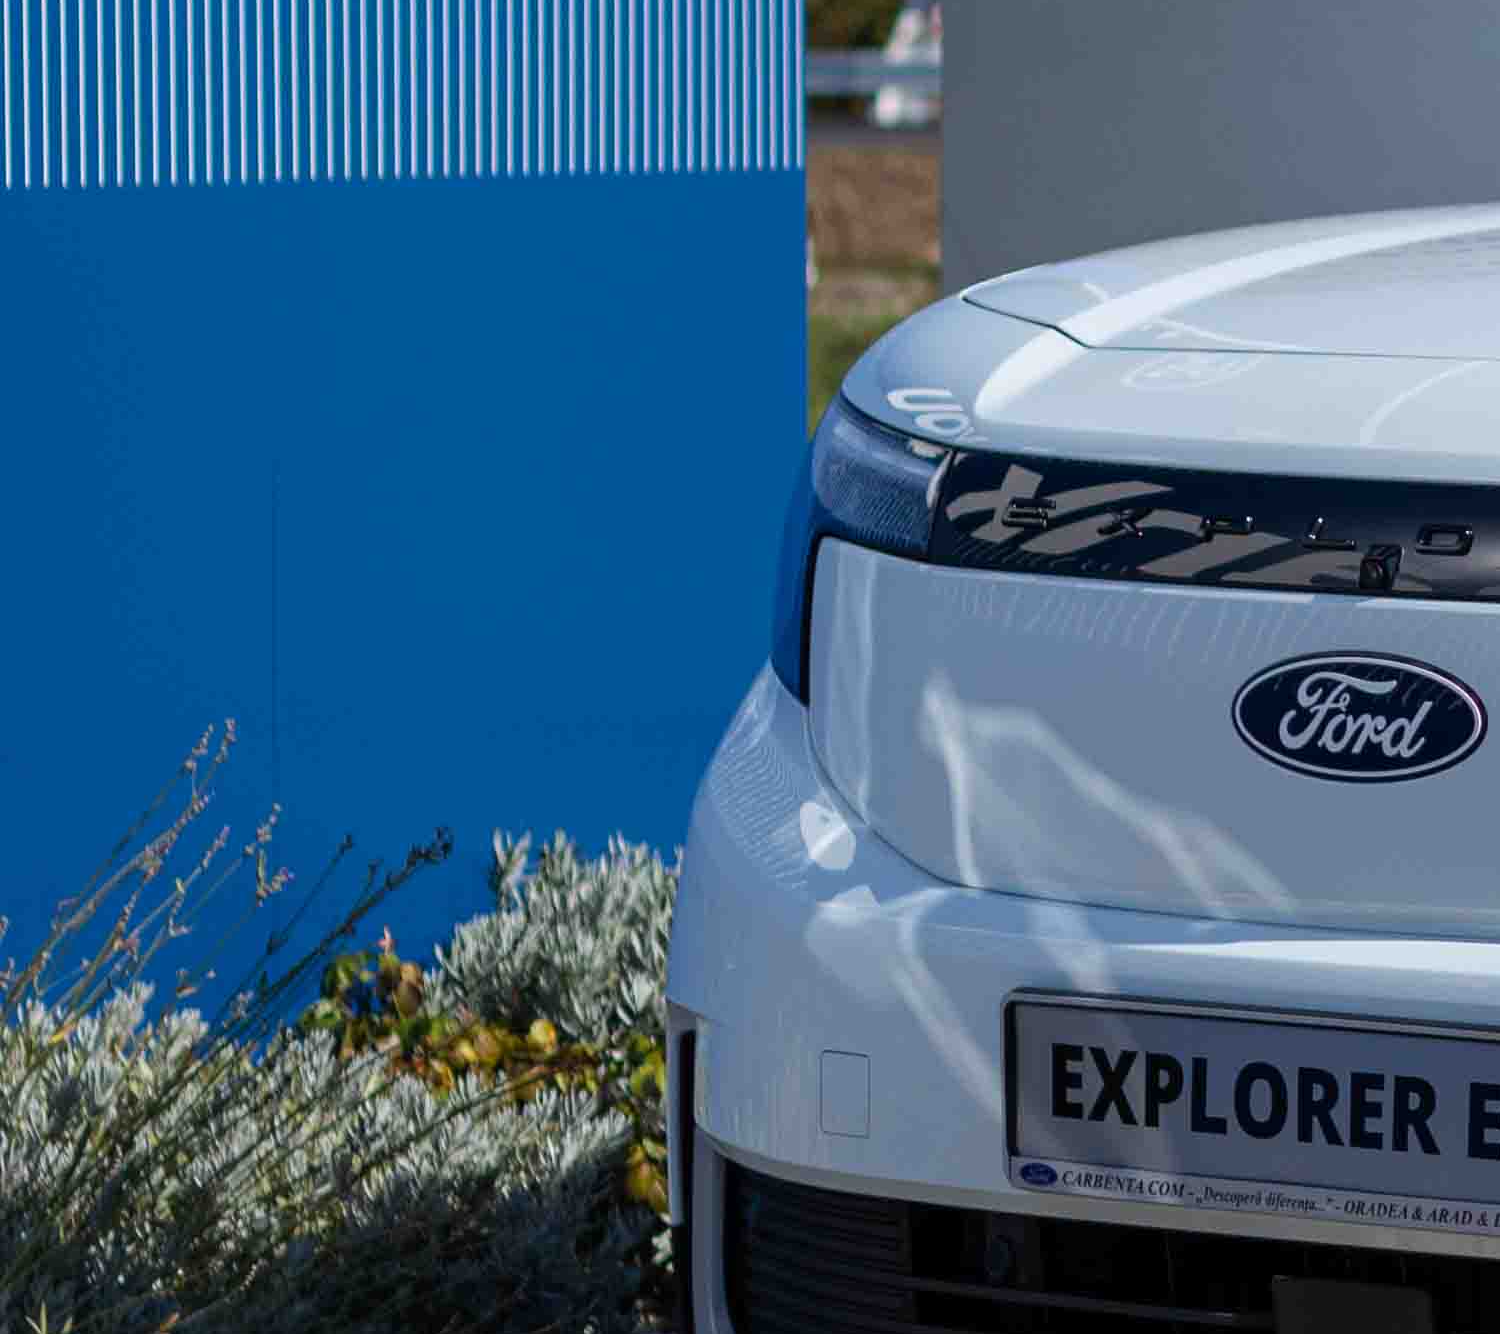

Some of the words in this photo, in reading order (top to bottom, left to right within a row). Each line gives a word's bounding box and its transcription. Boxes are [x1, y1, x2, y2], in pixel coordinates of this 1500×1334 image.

[1278, 671, 1433, 758] Ford
[1051, 1041, 1441, 1156] EXPLORER
[1062, 1169, 1144, 1196] CARBENTA
[1149, 1179, 1185, 1198] COM
[1343, 1199, 1409, 1220] ORADEA
[1411, 1207, 1425, 1222] &
[1426, 1208, 1474, 1226] ARAD
[1477, 1211, 1490, 1227] &
